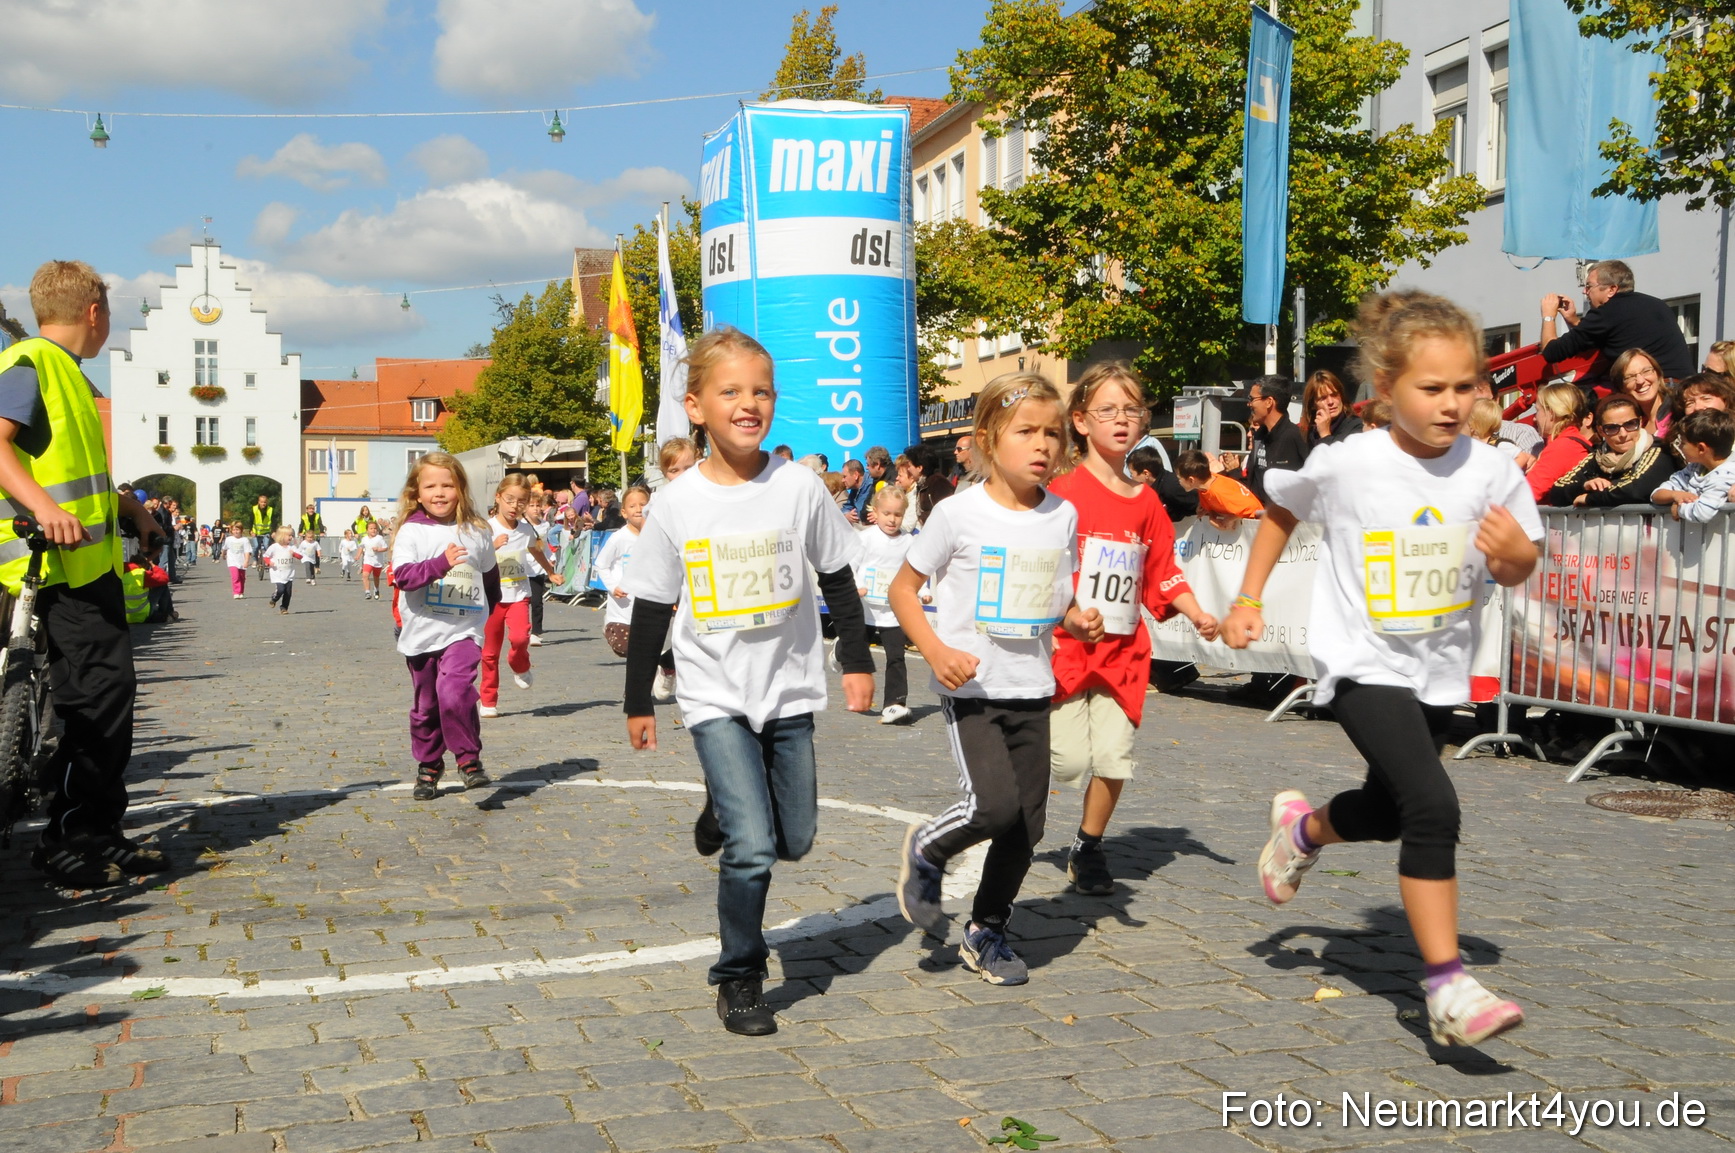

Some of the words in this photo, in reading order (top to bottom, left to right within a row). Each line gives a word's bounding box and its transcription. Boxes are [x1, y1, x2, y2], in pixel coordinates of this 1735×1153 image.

[701, 132, 733, 209] axi
[769, 129, 893, 194] maxi
[708, 233, 735, 277] dsl
[850, 227, 892, 268] dsl
[716, 539, 793, 563] Magdalena
[1011, 554, 1056, 573] Paulina
[1401, 538, 1448, 557] Laura
[447, 584, 480, 601] 7142
[722, 564, 794, 599] 7213
[1405, 564, 1476, 598] 7003
[1262, 624, 1293, 645] 09181
[1617, 612, 1696, 653] IBIZA
